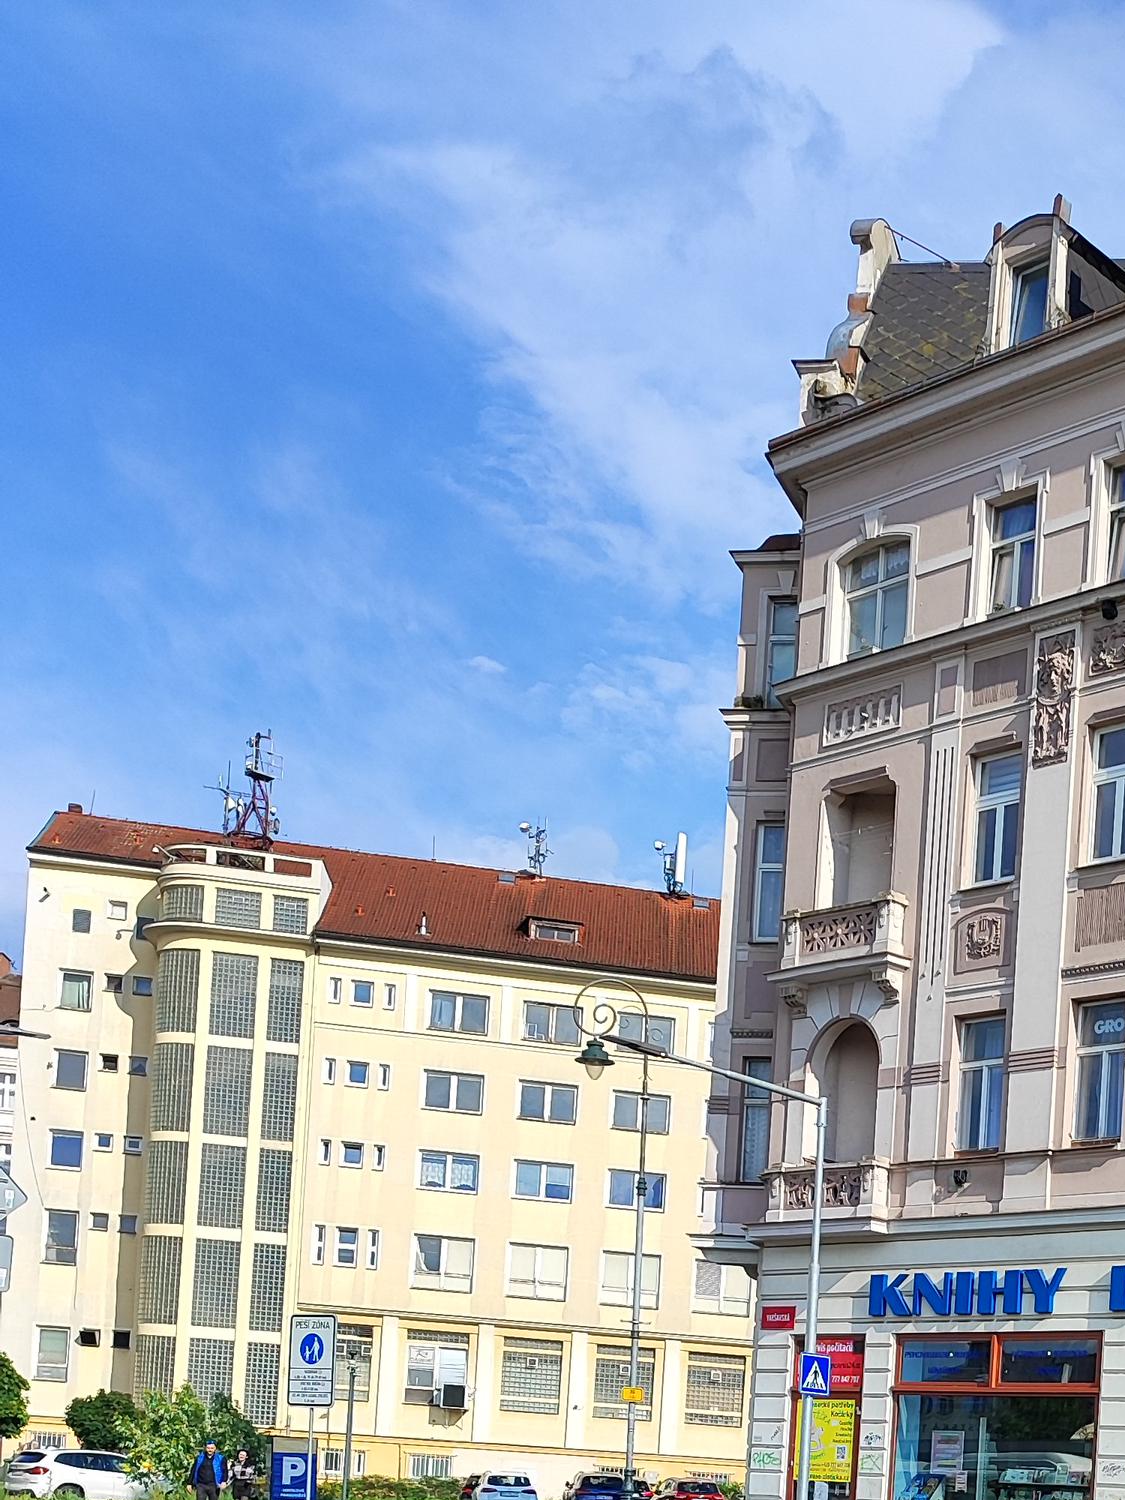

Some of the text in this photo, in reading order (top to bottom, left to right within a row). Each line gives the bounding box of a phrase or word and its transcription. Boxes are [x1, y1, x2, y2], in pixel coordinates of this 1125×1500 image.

[1094, 1018, 1125, 1034] GRO
[868, 1267, 1067, 1316] KNIHY
[311, 1320, 331, 1329] ZÓNA
[282, 1456, 306, 1485] P
